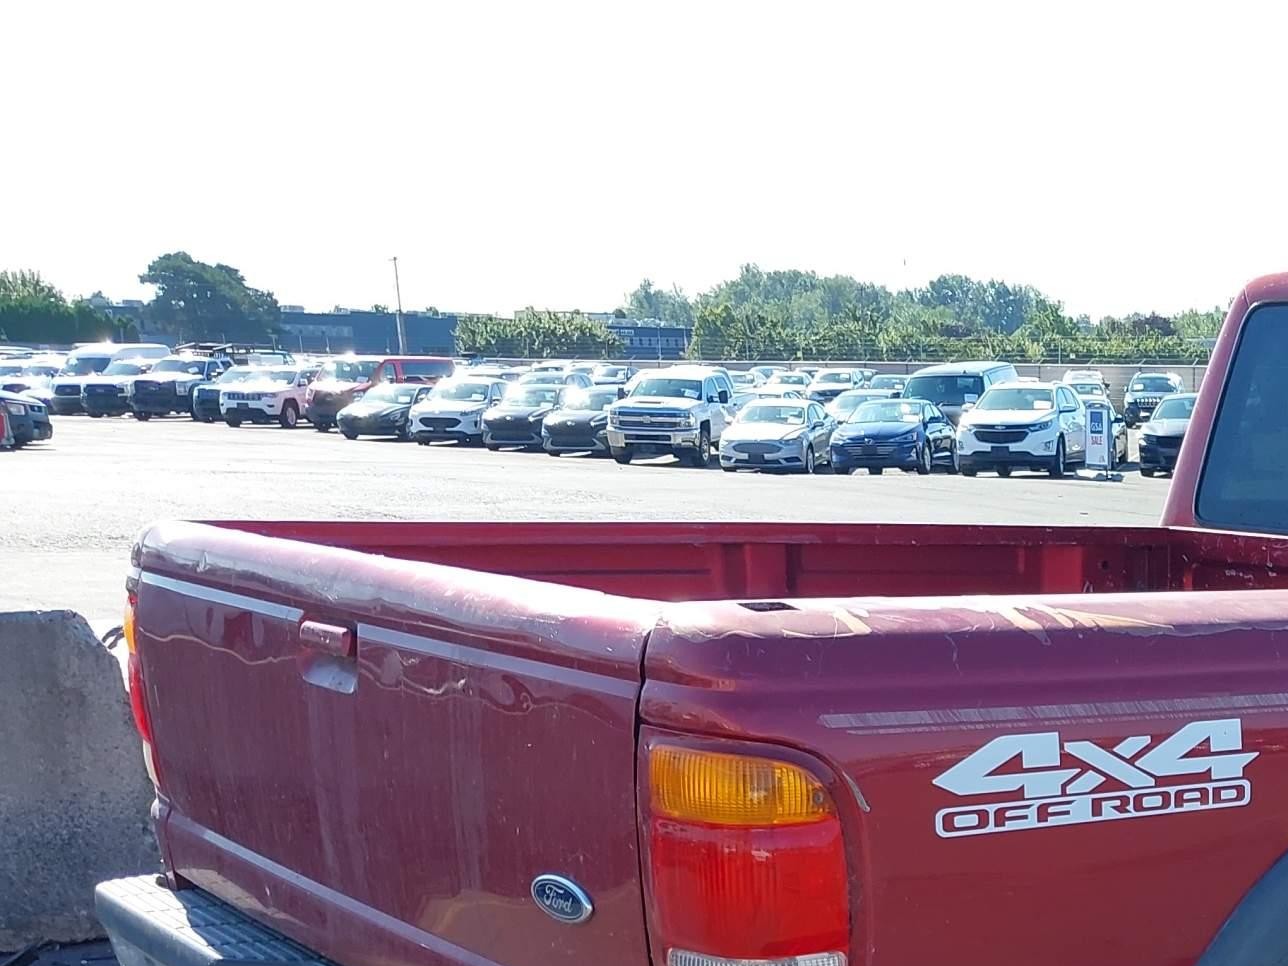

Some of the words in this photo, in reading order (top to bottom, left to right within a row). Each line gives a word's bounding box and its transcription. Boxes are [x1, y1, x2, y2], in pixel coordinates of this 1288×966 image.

[941, 799, 1077, 833] OFF
[1091, 784, 1246, 818] ROAD
[543, 884, 573, 913] Ford
